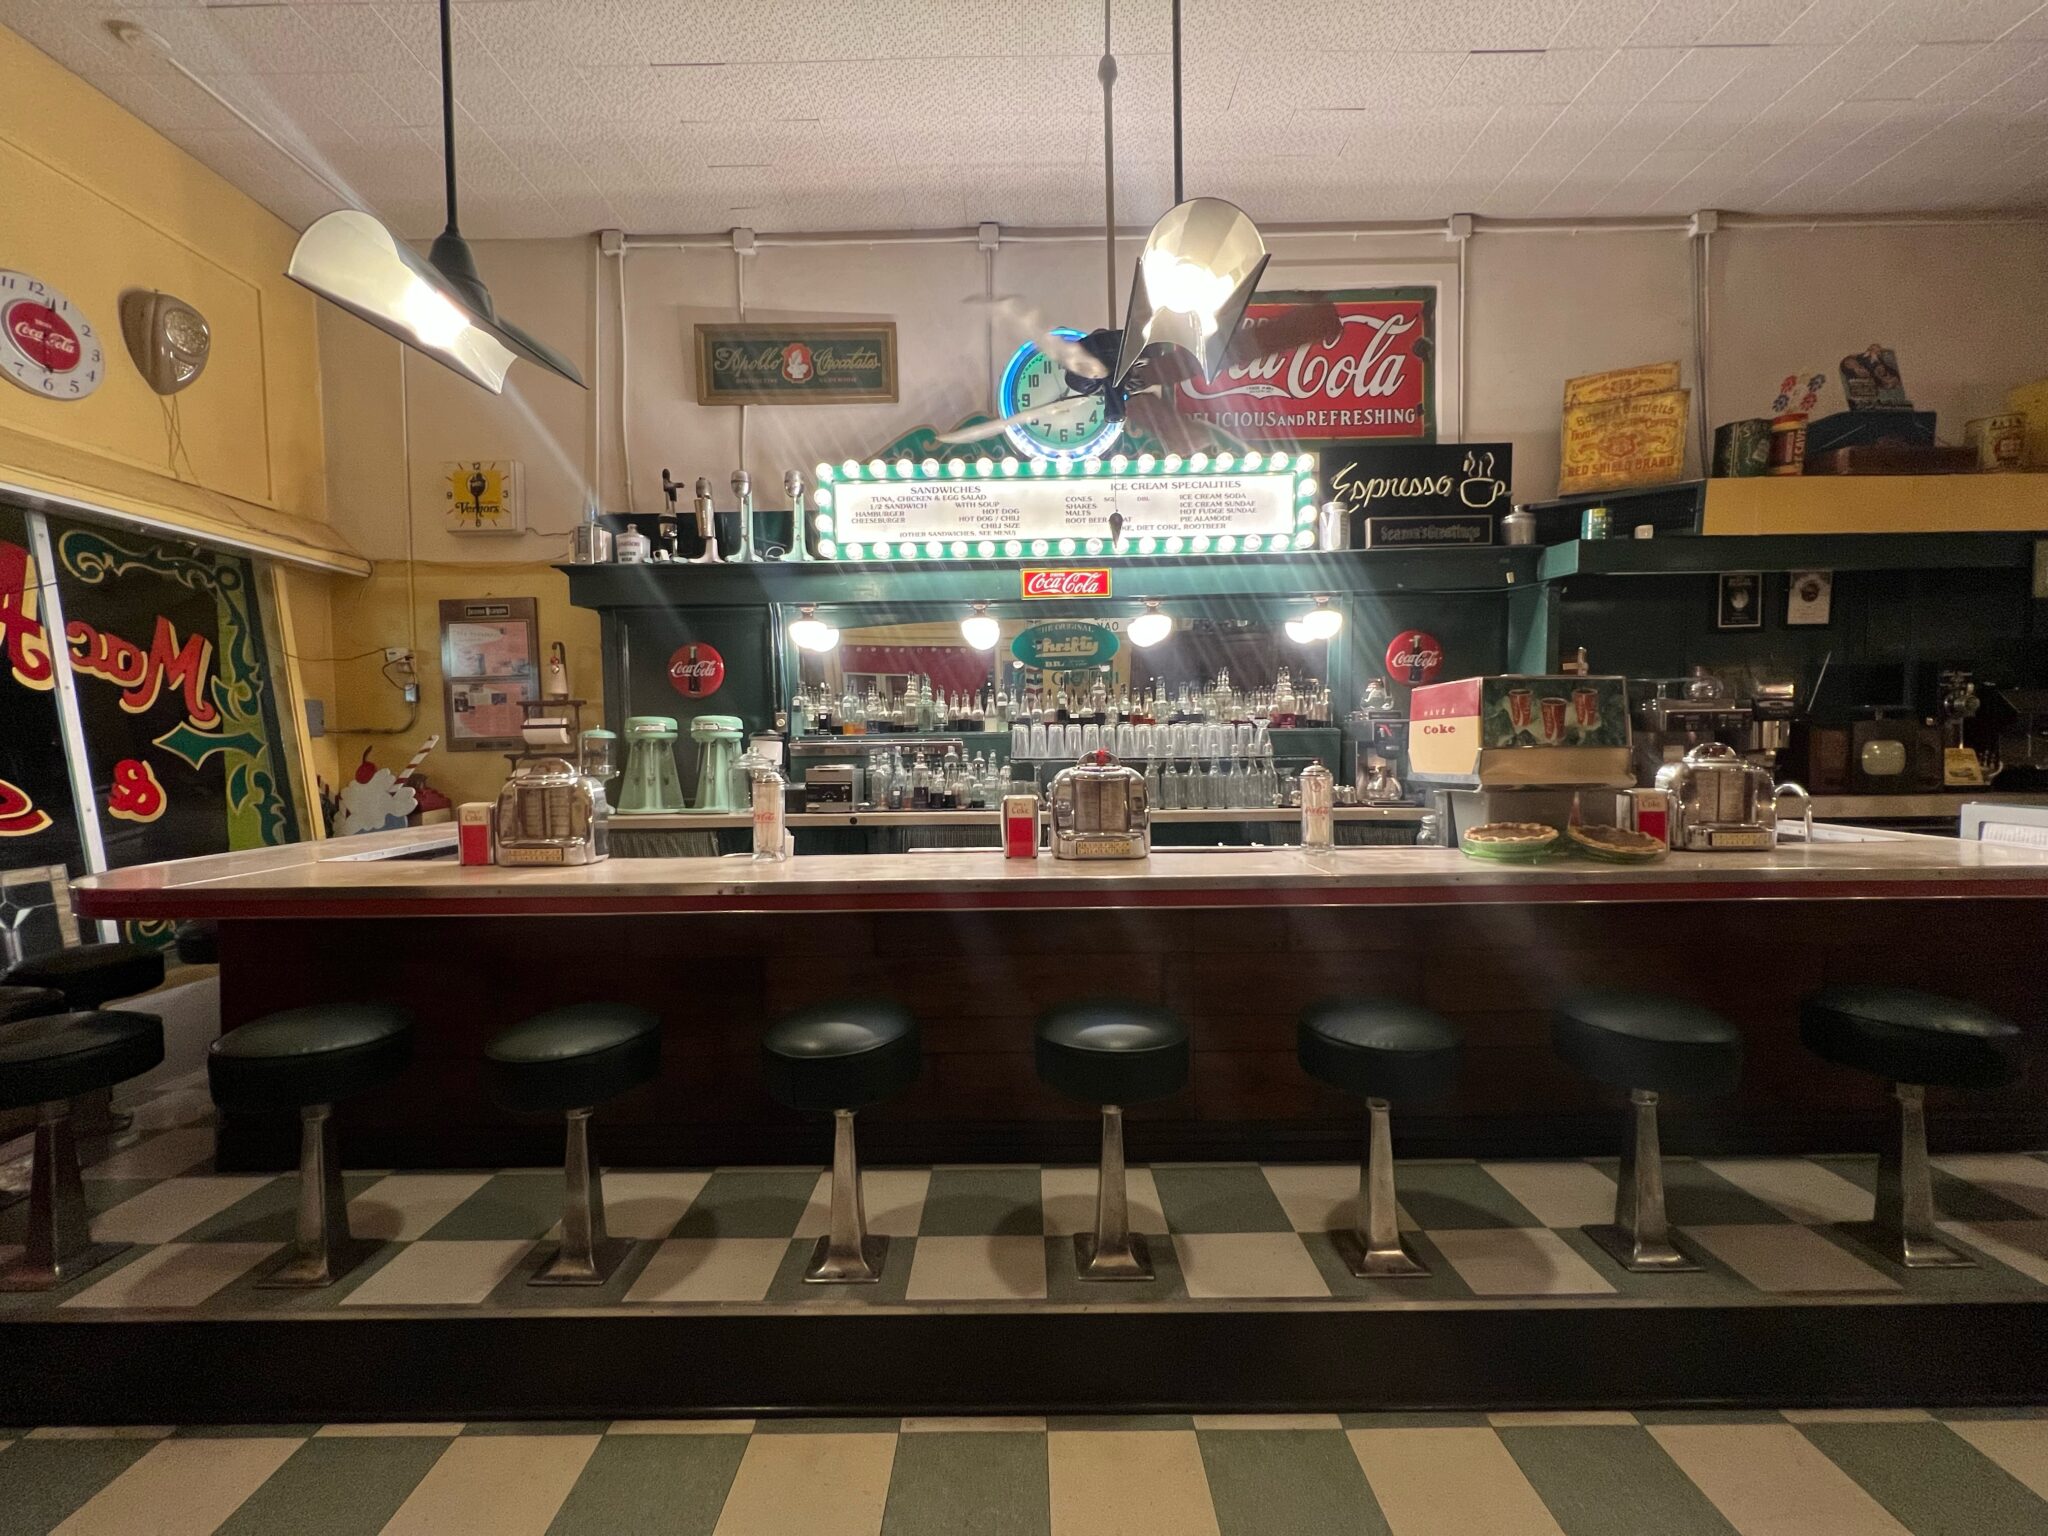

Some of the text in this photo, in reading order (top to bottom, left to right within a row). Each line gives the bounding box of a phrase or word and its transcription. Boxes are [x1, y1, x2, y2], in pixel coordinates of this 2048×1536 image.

[28, 280, 45, 296] 12
[80, 324, 92, 338] 2
[91, 348, 101, 362] 3
[43, 378, 54, 391] 6
[69, 380, 80, 393] 5
[1028, 374, 1039, 388] 10
[1022, 393, 1031, 407] 9
[1089, 410, 1098, 424] 4
[1306, 408, 1416, 426] REFRESHING
[1043, 423, 1052, 437] 7
[1060, 428, 1068, 442] 6
[1076, 422, 1085, 436] 5
[910, 485, 981, 495] SANDWICHES
[1110, 480, 1241, 491] ICE CREAM SPECIALITIES
[1331, 462, 1455, 514] Espresso
[502, 490, 509, 498] 3
[1183, 522, 1226, 530] ROOTBEER
[1423, 724, 1456, 735] Coke
